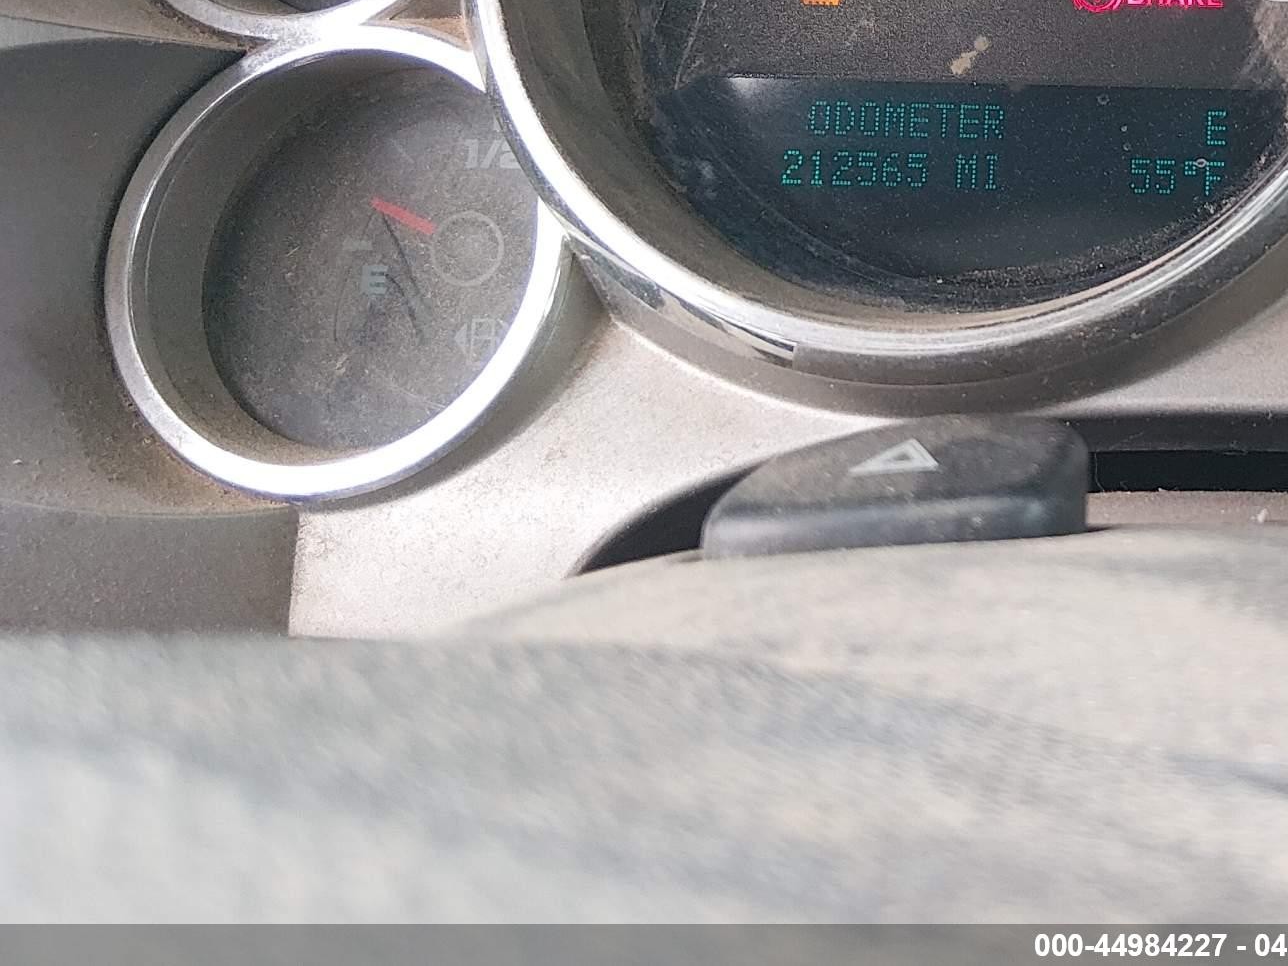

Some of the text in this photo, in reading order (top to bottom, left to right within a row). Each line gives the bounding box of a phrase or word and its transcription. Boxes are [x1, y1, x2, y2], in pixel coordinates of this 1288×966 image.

[808, 100, 1005, 139] ODOMETER
[1206, 111, 1227, 145] E
[780, 149, 999, 190] 212565 MI
[359, 264, 388, 296] E
